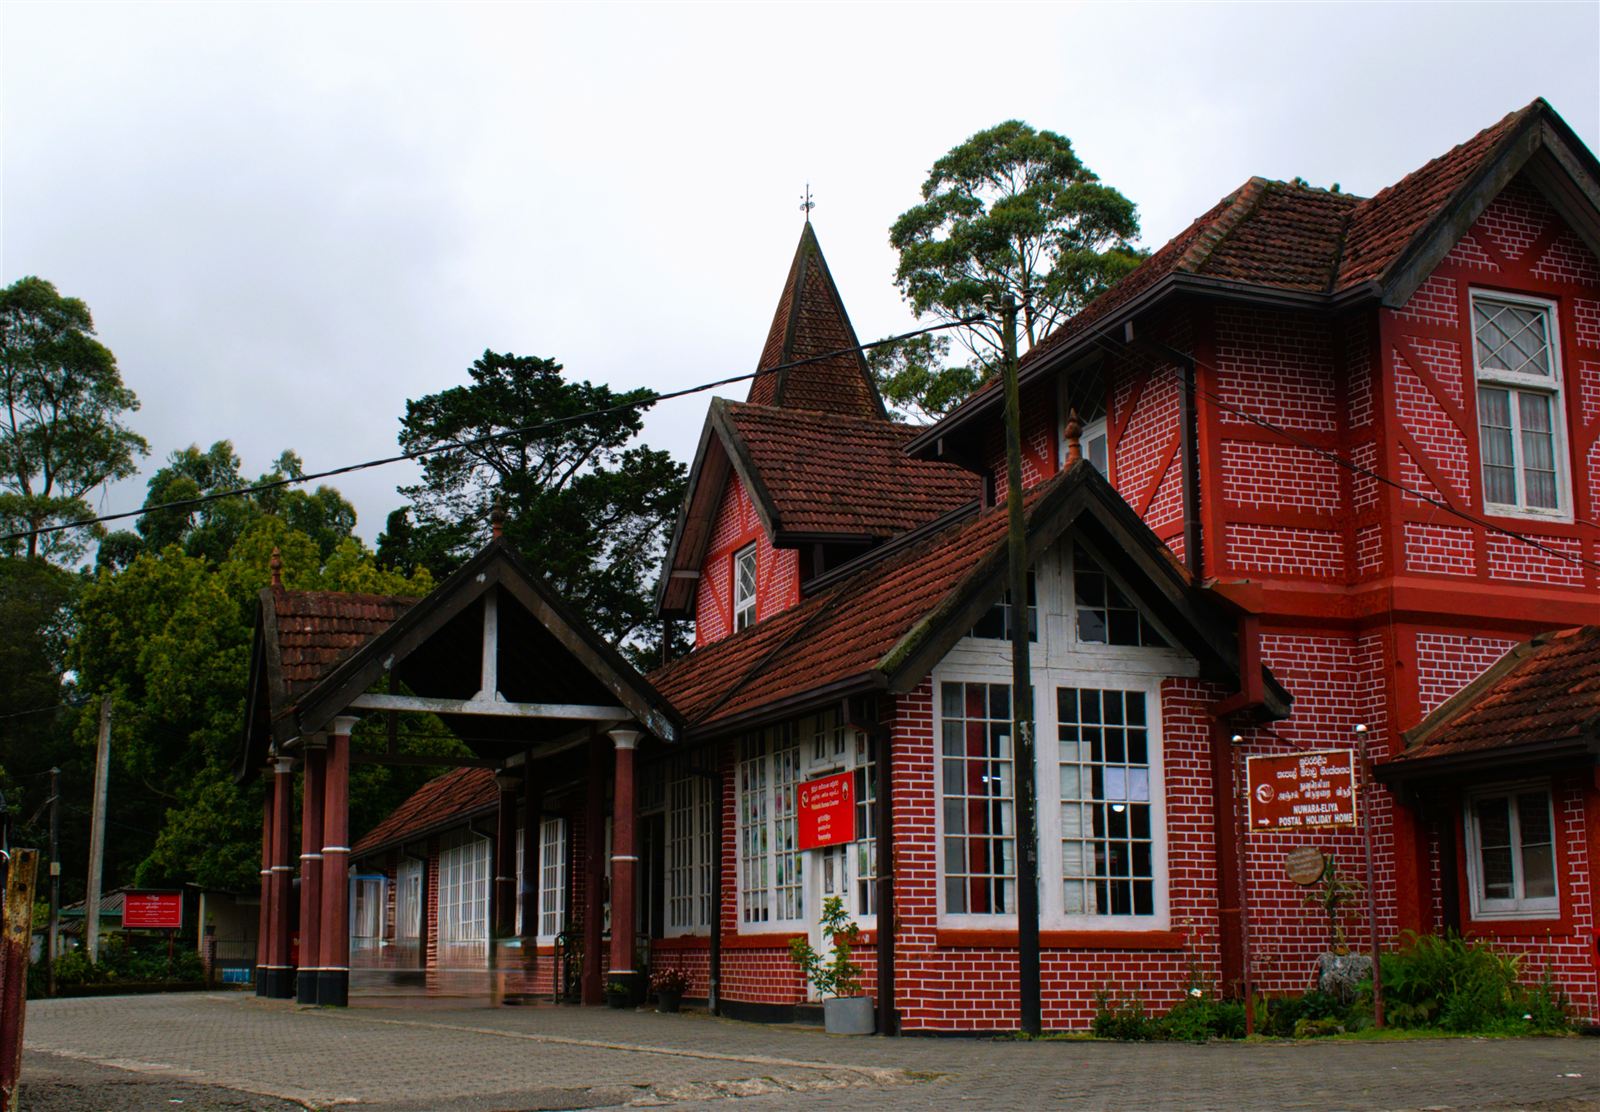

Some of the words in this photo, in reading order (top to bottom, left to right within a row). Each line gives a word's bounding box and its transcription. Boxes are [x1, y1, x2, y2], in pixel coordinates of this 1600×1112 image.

[1293, 803, 1338, 814] NUWARA-ELIYA
[1279, 816, 1302, 825] POSTAL
[1305, 814, 1331, 824] HOLIDAY
[1334, 813, 1352, 822] HOME
